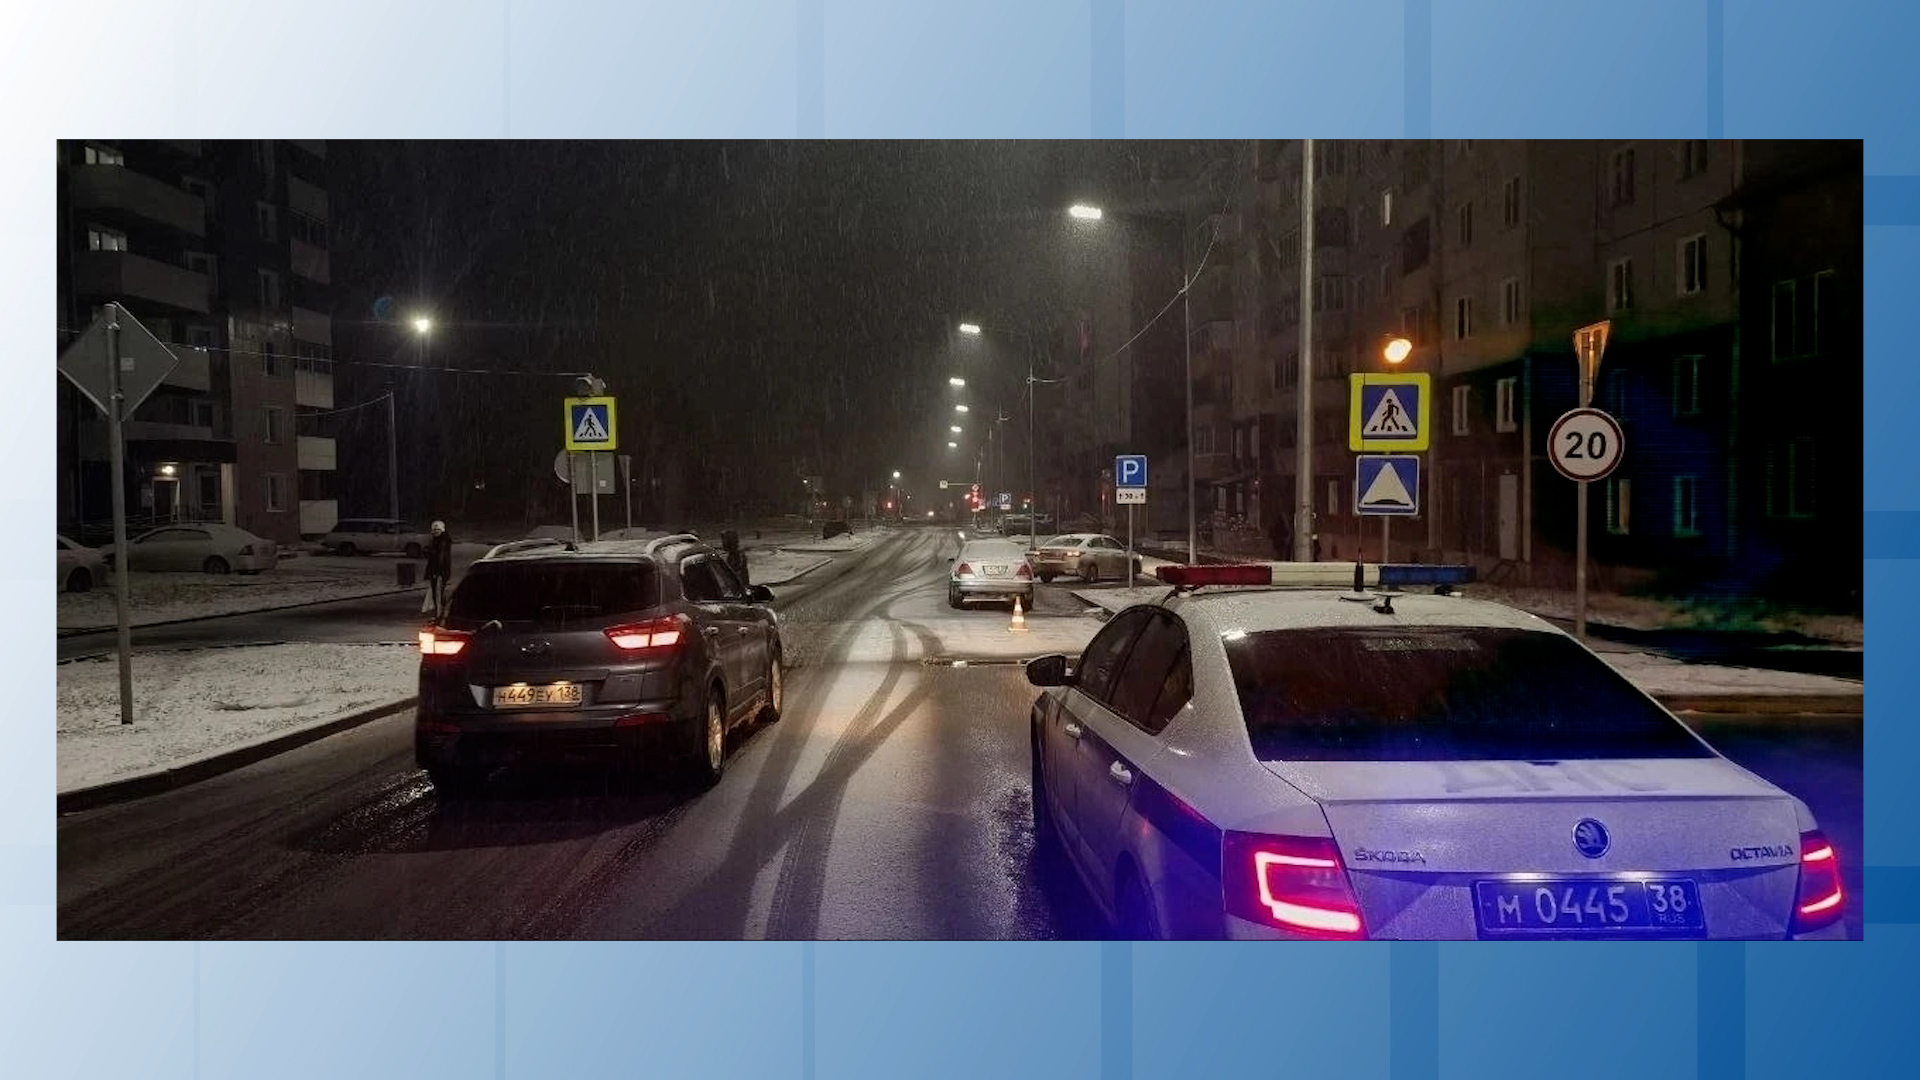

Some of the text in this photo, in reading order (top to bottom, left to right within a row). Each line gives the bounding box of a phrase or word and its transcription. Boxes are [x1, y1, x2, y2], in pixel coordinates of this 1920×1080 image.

[1565, 431, 1606, 459] 20
[1123, 460, 1139, 483] P
[1730, 845, 1794, 861] OCTAVIA
[1534, 886, 1630, 925] 0445
[1649, 885, 1687, 913] 38
